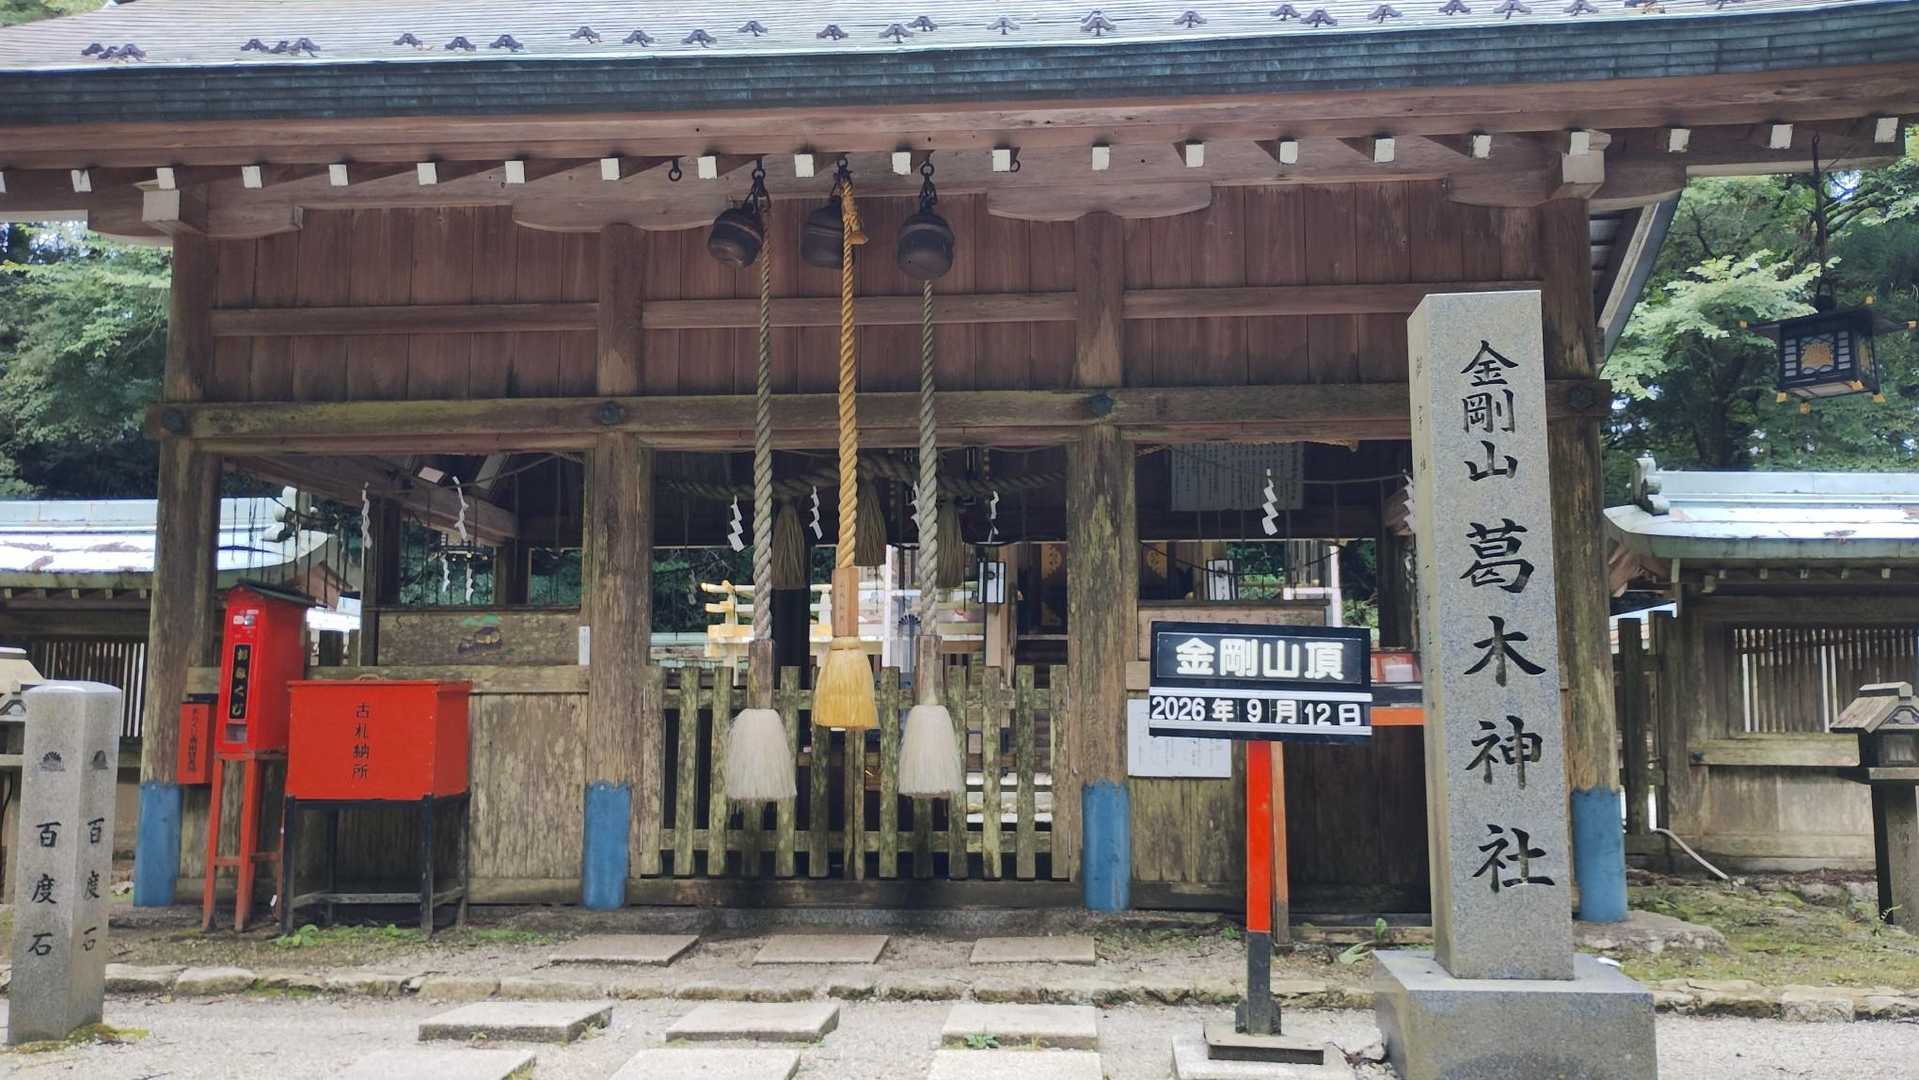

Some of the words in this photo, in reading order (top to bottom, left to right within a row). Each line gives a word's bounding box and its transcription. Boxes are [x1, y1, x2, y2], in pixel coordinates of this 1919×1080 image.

[1175, 637, 1345, 681] 金剛山頂
[352, 702, 370, 779] 古札納所
[27, 822, 62, 957] 百度石
[81, 816, 106, 953] 百度石
